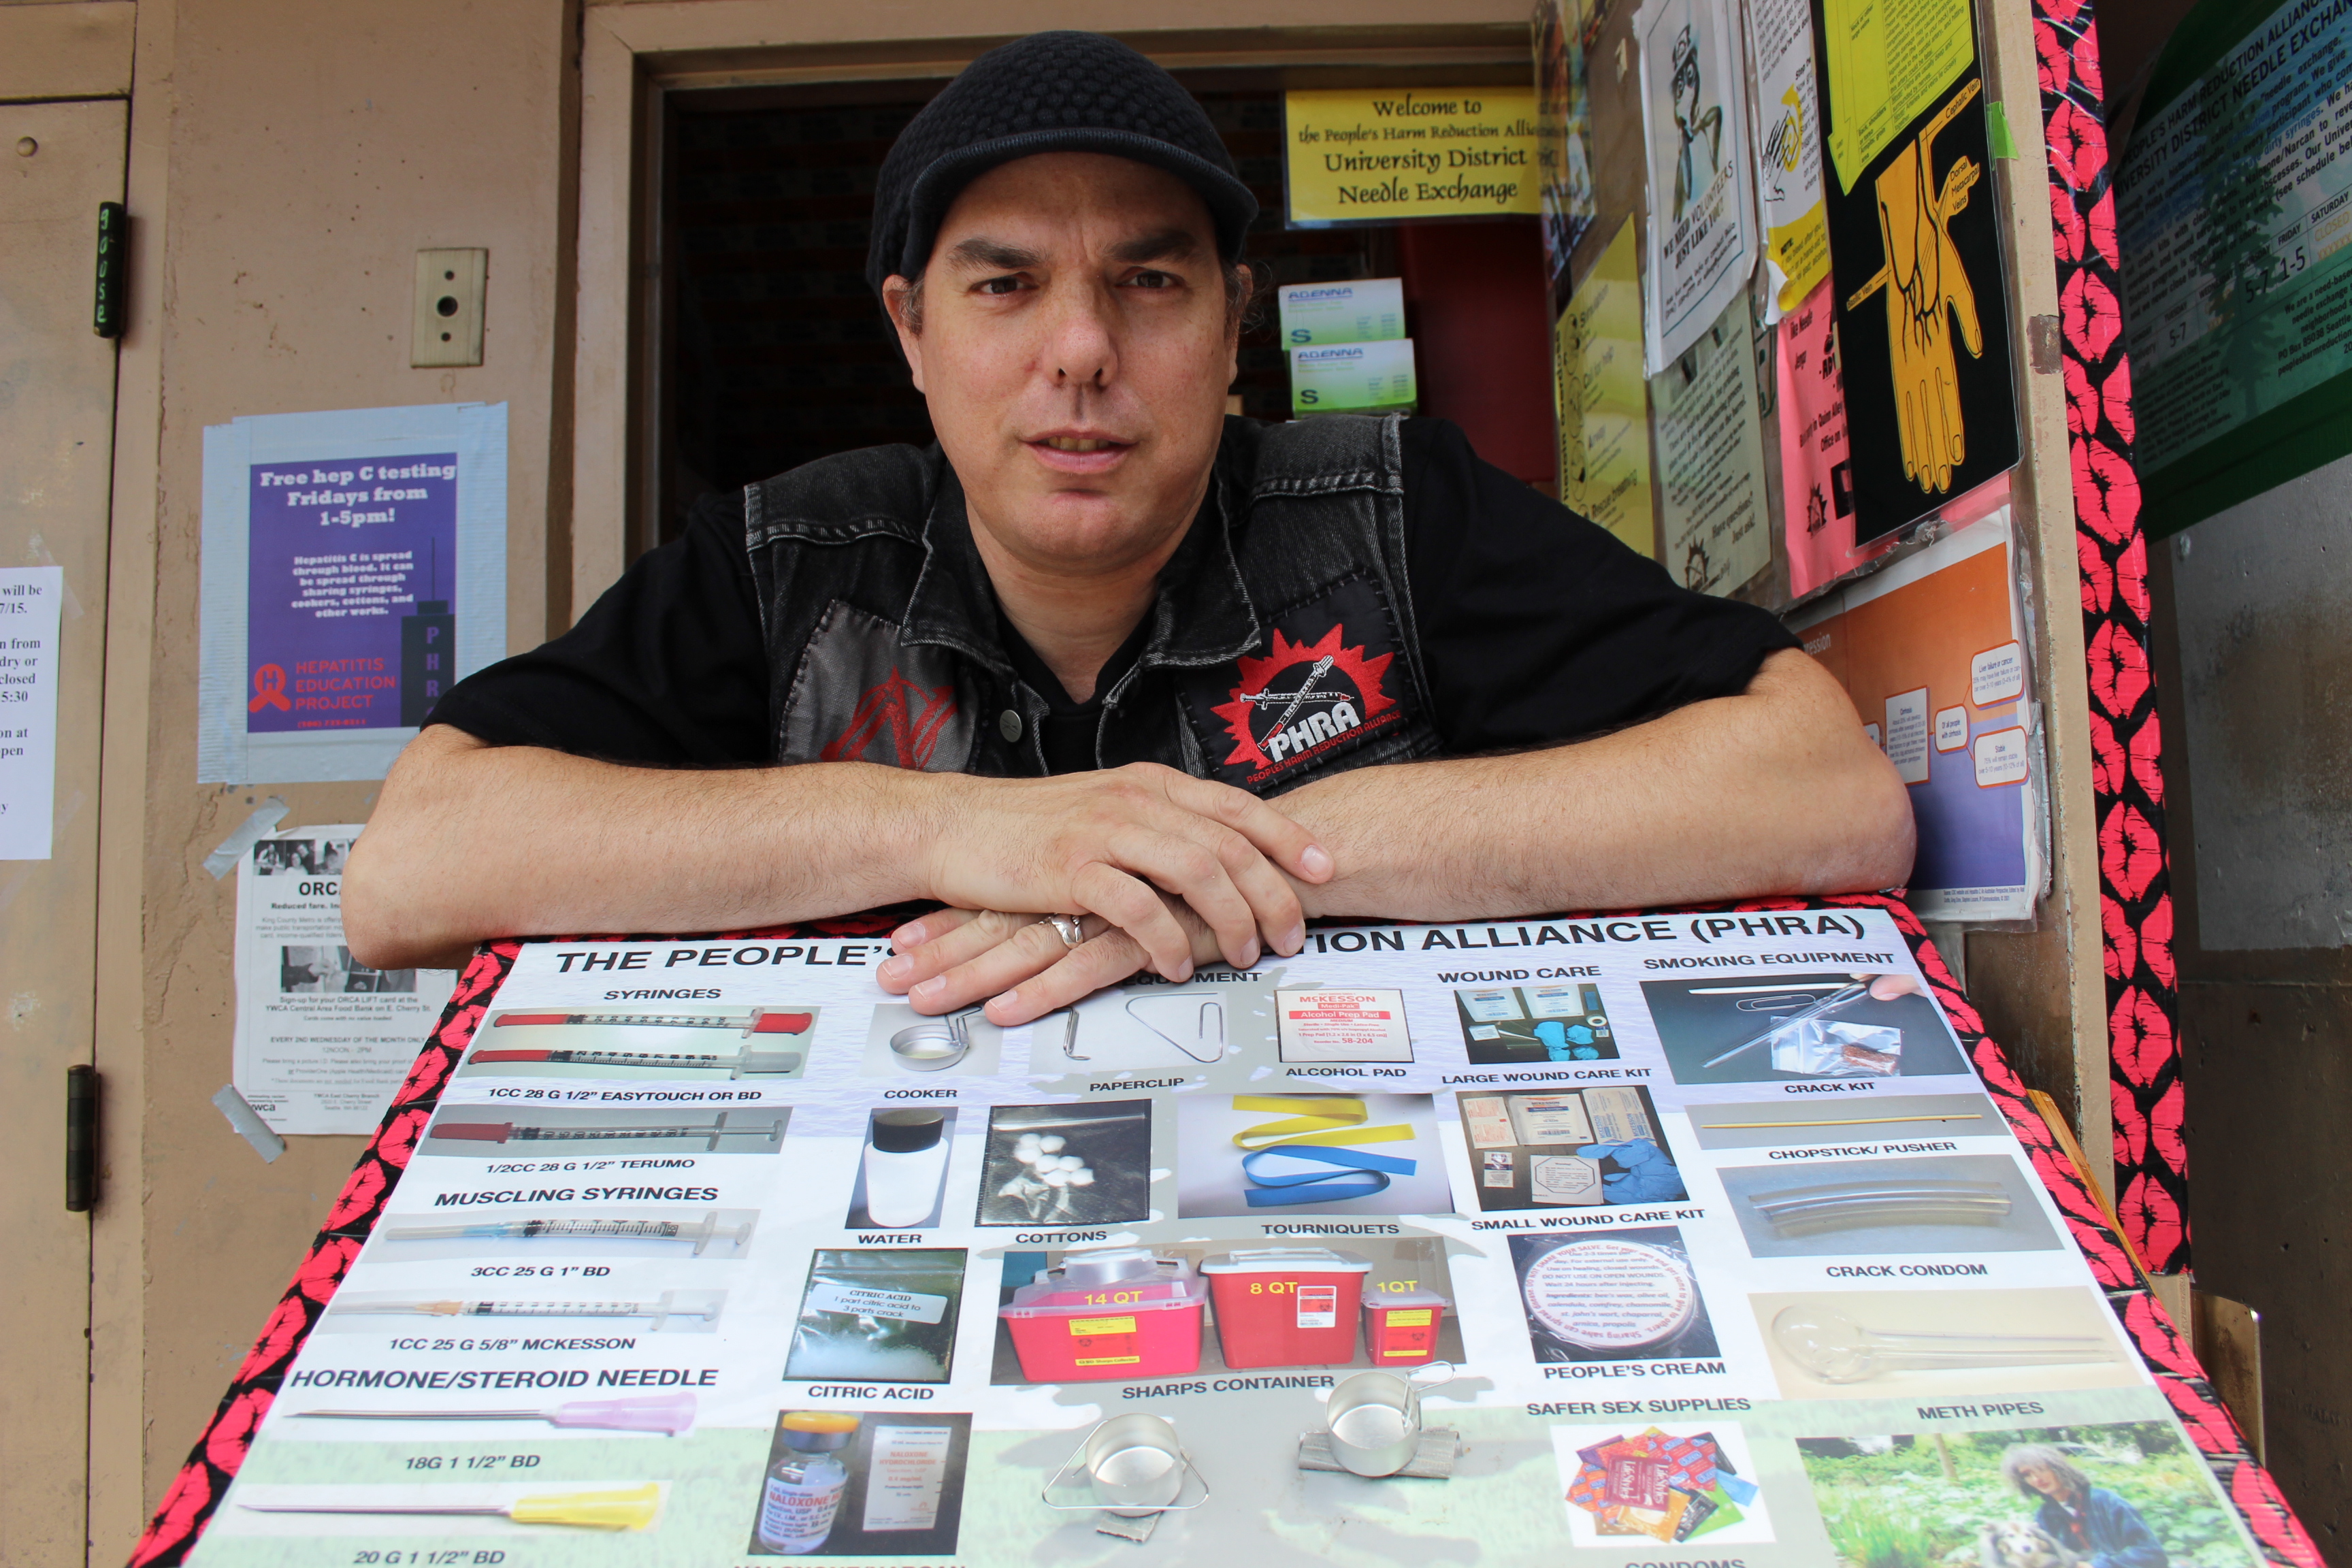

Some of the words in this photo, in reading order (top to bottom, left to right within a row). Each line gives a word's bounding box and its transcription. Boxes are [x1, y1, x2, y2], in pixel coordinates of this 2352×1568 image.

[2167, 91, 2198, 130] HARM
[2199, 40, 2264, 101] REDUCTION
[2268, 0, 2321, 48] ALLIANC
[1373, 93, 1458, 117] Welcome
[1465, 99, 1482, 114] to
[1945, 91, 1967, 119] Cephalic
[1967, 79, 1980, 95] Vein
[2171, 93, 2228, 153] DISTRICT
[2232, 44, 2287, 103] NEEDLE
[1299, 125, 1320, 142] the
[1383, 127, 1426, 140] Harm
[1431, 122, 1498, 139] Reduction
[1324, 148, 1441, 173] University
[1448, 146, 1528, 167] District
[1949, 161, 1968, 182] Dorsal
[1339, 176, 1409, 204] Needle
[1416, 174, 1518, 203] Exchange
[1950, 165, 1979, 197] Metacarpal
[1952, 195, 1967, 212] Veins
[2311, 191, 2349, 223] SATURDAY
[2277, 223, 2302, 246] FRIDAY
[2280, 246, 2306, 281] 1-5
[1288, 287, 1353, 299] ADENNA
[1847, 287, 1861, 308] Basilic
[1861, 282, 1873, 297] Vein
[1290, 329, 1312, 343] S
[1298, 348, 1364, 359] ADENNA
[1301, 389, 1319, 404] S
[260, 472, 309, 487] Free
[313, 469, 354, 486] hep
[359, 466, 375, 480] C
[378, 463, 457, 481] testing
[287, 490, 369, 506] Fridays
[373, 487, 427, 502] from
[320, 508, 395, 527] 1-5pm!
[294, 554, 346, 566] Hepatitis
[348, 553, 357, 563] C
[359, 553, 370, 562] is
[372, 551, 412, 564] spread
[3, 585, 25, 595] will
[29, 585, 42, 596] be
[11, 638, 41, 649] from
[296, 657, 385, 674] HEPATITIS
[1978, 664, 1987, 673] Liver
[1987, 662, 1997, 670] failure
[2001, 657, 2013, 666] cancer
[296, 675, 395, 692] EDUCATION
[1, 691, 28, 702] 5:30
[296, 695, 374, 710] PROJECT
[1267, 701, 1361, 763] PHRA
[1246, 764, 1284, 785] PEOPLES
[1284, 750, 1312, 766] HARM
[1313, 726, 1362, 755] REDUCTION
[1364, 710, 1402, 732] ALLIANCE
[299, 882, 341, 896] ORC
[1422, 921, 1676, 949] ALLIANCE
[1691, 915, 1864, 943] (PHRA)
[557, 951, 653, 973] THE
[665, 945, 897, 968] PEOPLE'
[1644, 955, 1755, 969] SMOKING
[1760, 952, 1894, 964] EQUIPMENT
[1113, 970, 1263, 992] EQUMENT
[1436, 968, 1531, 984] WOUND
[1535, 964, 1603, 979] CARE
[604, 988, 721, 1000] SYRINGES
[1300, 1011, 1337, 1019] Alcohol
[1338, 1011, 1360, 1019] Prep
[1362, 1011, 1380, 1019] Pad
[1284, 1066, 1369, 1079] ALCOHOL
[1373, 1068, 1407, 1077] PAD
[1441, 1073, 1500, 1085] LARGE
[1502, 1071, 1570, 1083] WOUND
[1573, 1068, 1622, 1081] CARE
[1624, 1068, 1651, 1077] KIT
[1090, 1077, 1184, 1092] PAPERCLIP
[1784, 1083, 1846, 1093] CRACK
[1848, 1081, 1874, 1091] KIT
[489, 1088, 521, 1098] 1CC
[524, 1089, 544, 1098] 28
[548, 1090, 561, 1099] G
[601, 1092, 704, 1100] EASYTOUCH
[708, 1092, 734, 1100] OR
[738, 1092, 762, 1100] BD
[884, 1089, 958, 1098] COOKER
[1767, 1145, 1878, 1162] CHOPSTICK/
[1883, 1142, 1957, 1154] PUSHER
[487, 1163, 536, 1173] 1/2CC
[539, 1163, 559, 1171] 28
[564, 1162, 576, 1171] G
[621, 1159, 696, 1169] TERUMO
[434, 1188, 576, 1206] MUSCLING
[582, 1187, 719, 1200] SYRINGES
[1471, 1219, 1536, 1230] SMALL
[1539, 1215, 1614, 1227] WOUND
[1618, 1211, 1671, 1222] CARE
[1675, 1209, 1705, 1219] KIT
[1015, 1230, 1107, 1243] COTTONS
[1260, 1224, 1400, 1235] TOURNIQUETS
[858, 1234, 922, 1244] WATER
[471, 1267, 510, 1277] 3CC
[513, 1267, 536, 1276] 25
[540, 1267, 554, 1276] G
[583, 1267, 610, 1276] BD
[1826, 1265, 1895, 1277] CRACK
[1899, 1264, 1988, 1276] CONDOM
[849, 1290, 885, 1298] CITRIC
[1250, 1282, 1264, 1295] 8
[1268, 1281, 1298, 1294] QT
[1377, 1280, 1418, 1293] 1QT
[1085, 1293, 1107, 1305] 14
[1113, 1290, 1143, 1304] QT
[391, 1338, 428, 1350] 1CC
[431, 1339, 455, 1350] 25
[459, 1339, 474, 1350] G
[522, 1338, 636, 1350] MCKESSON
[1650, 1362, 1726, 1375] CREAM
[290, 1369, 589, 1389] HORMONE/STEROID
[597, 1369, 719, 1386] NEEDLE
[1122, 1382, 1207, 1399] SHARPS
[1213, 1375, 1335, 1392] CONTAINER
[808, 1386, 877, 1399] CITRIC
[883, 1388, 934, 1399] ACID
[1526, 1403, 1597, 1416] SAFER
[1601, 1401, 1644, 1414] SEX
[1648, 1398, 1751, 1413] SUPPLIES
[1916, 1405, 1979, 1420] METH
[1981, 1401, 2044, 1416] PIPES
[406, 1456, 442, 1469] 18G
[451, 1456, 459, 1469] 1
[510, 1455, 541, 1468] BD
